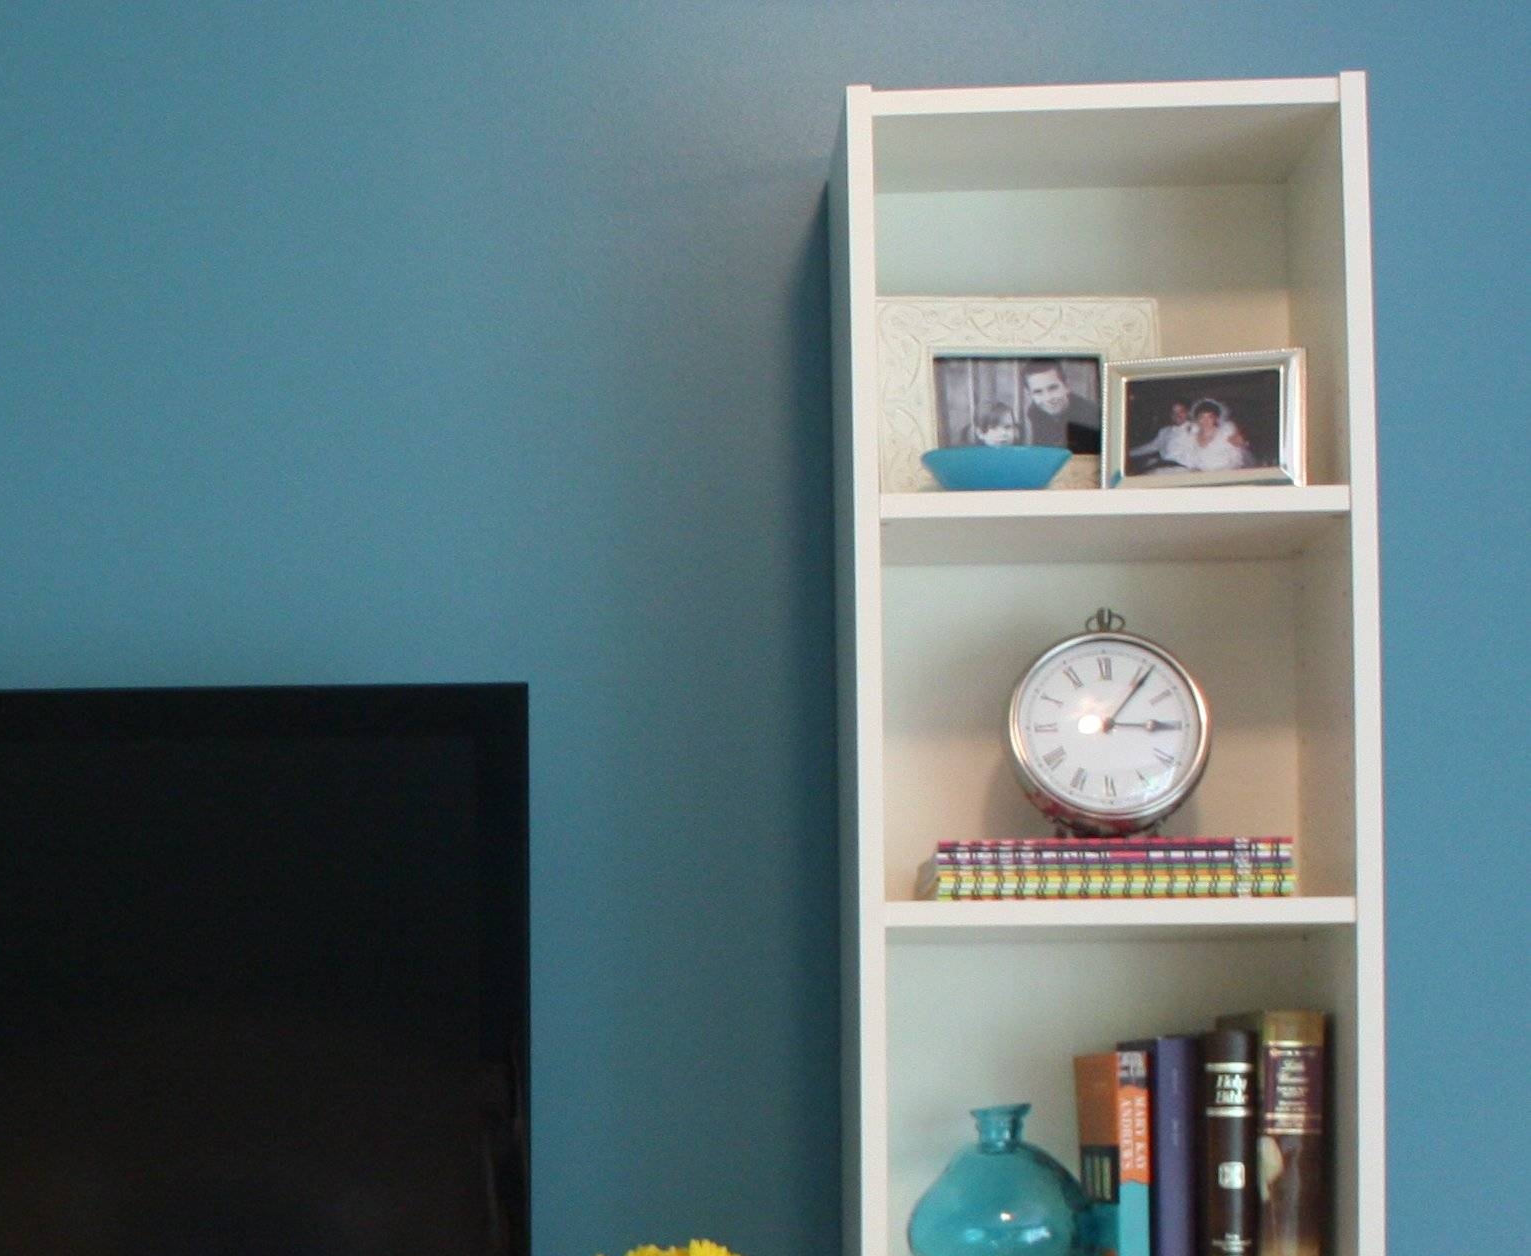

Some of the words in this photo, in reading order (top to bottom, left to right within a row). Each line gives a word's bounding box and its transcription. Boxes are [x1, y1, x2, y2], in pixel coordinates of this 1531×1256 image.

[1121, 1098, 1133, 1171] ANDREWS
[1135, 1096, 1146, 1138] MARY
[1135, 1142, 1146, 1170] KAY
